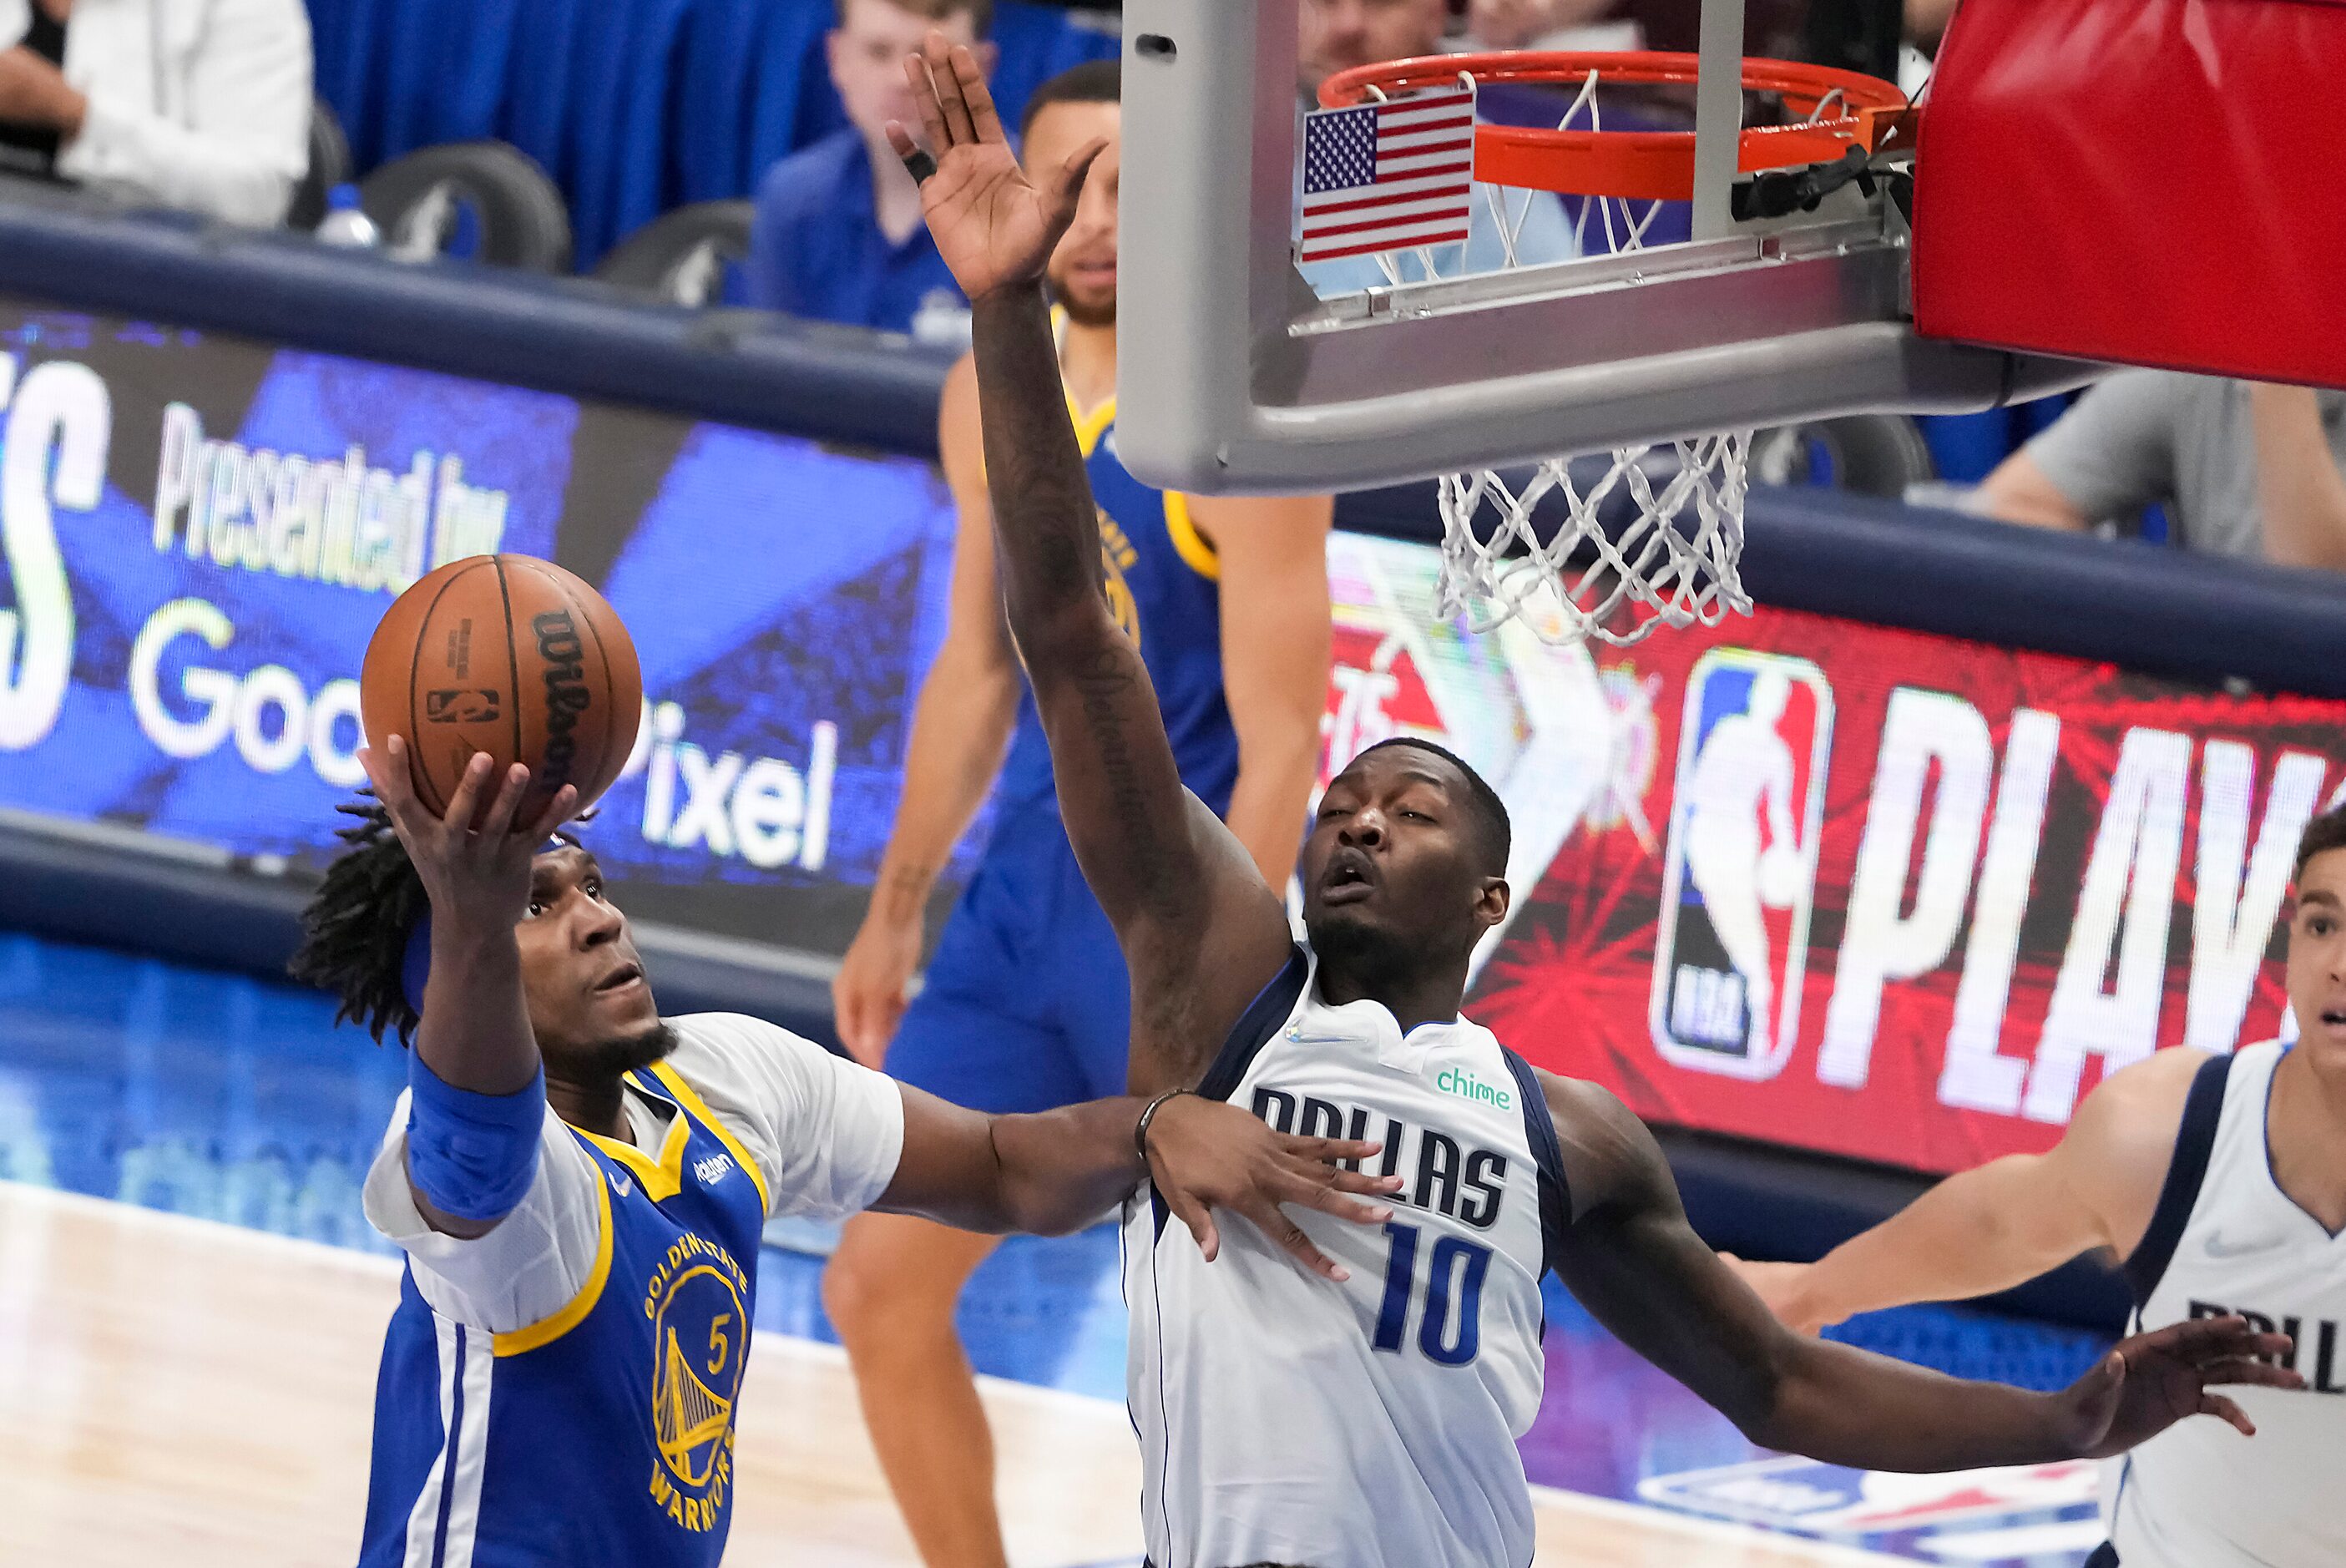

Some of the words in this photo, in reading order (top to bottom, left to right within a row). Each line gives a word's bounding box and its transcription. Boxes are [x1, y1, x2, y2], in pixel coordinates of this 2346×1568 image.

[533, 609, 590, 793] Wilson
[1817, 684, 2346, 1125] PLAY
[1437, 1067, 1512, 1111] chime
[644, 1232, 703, 1321] GOLDEN
[695, 1237, 749, 1296] STATE
[1372, 1222, 1495, 1368] 10
[708, 1312, 732, 1377] 5
